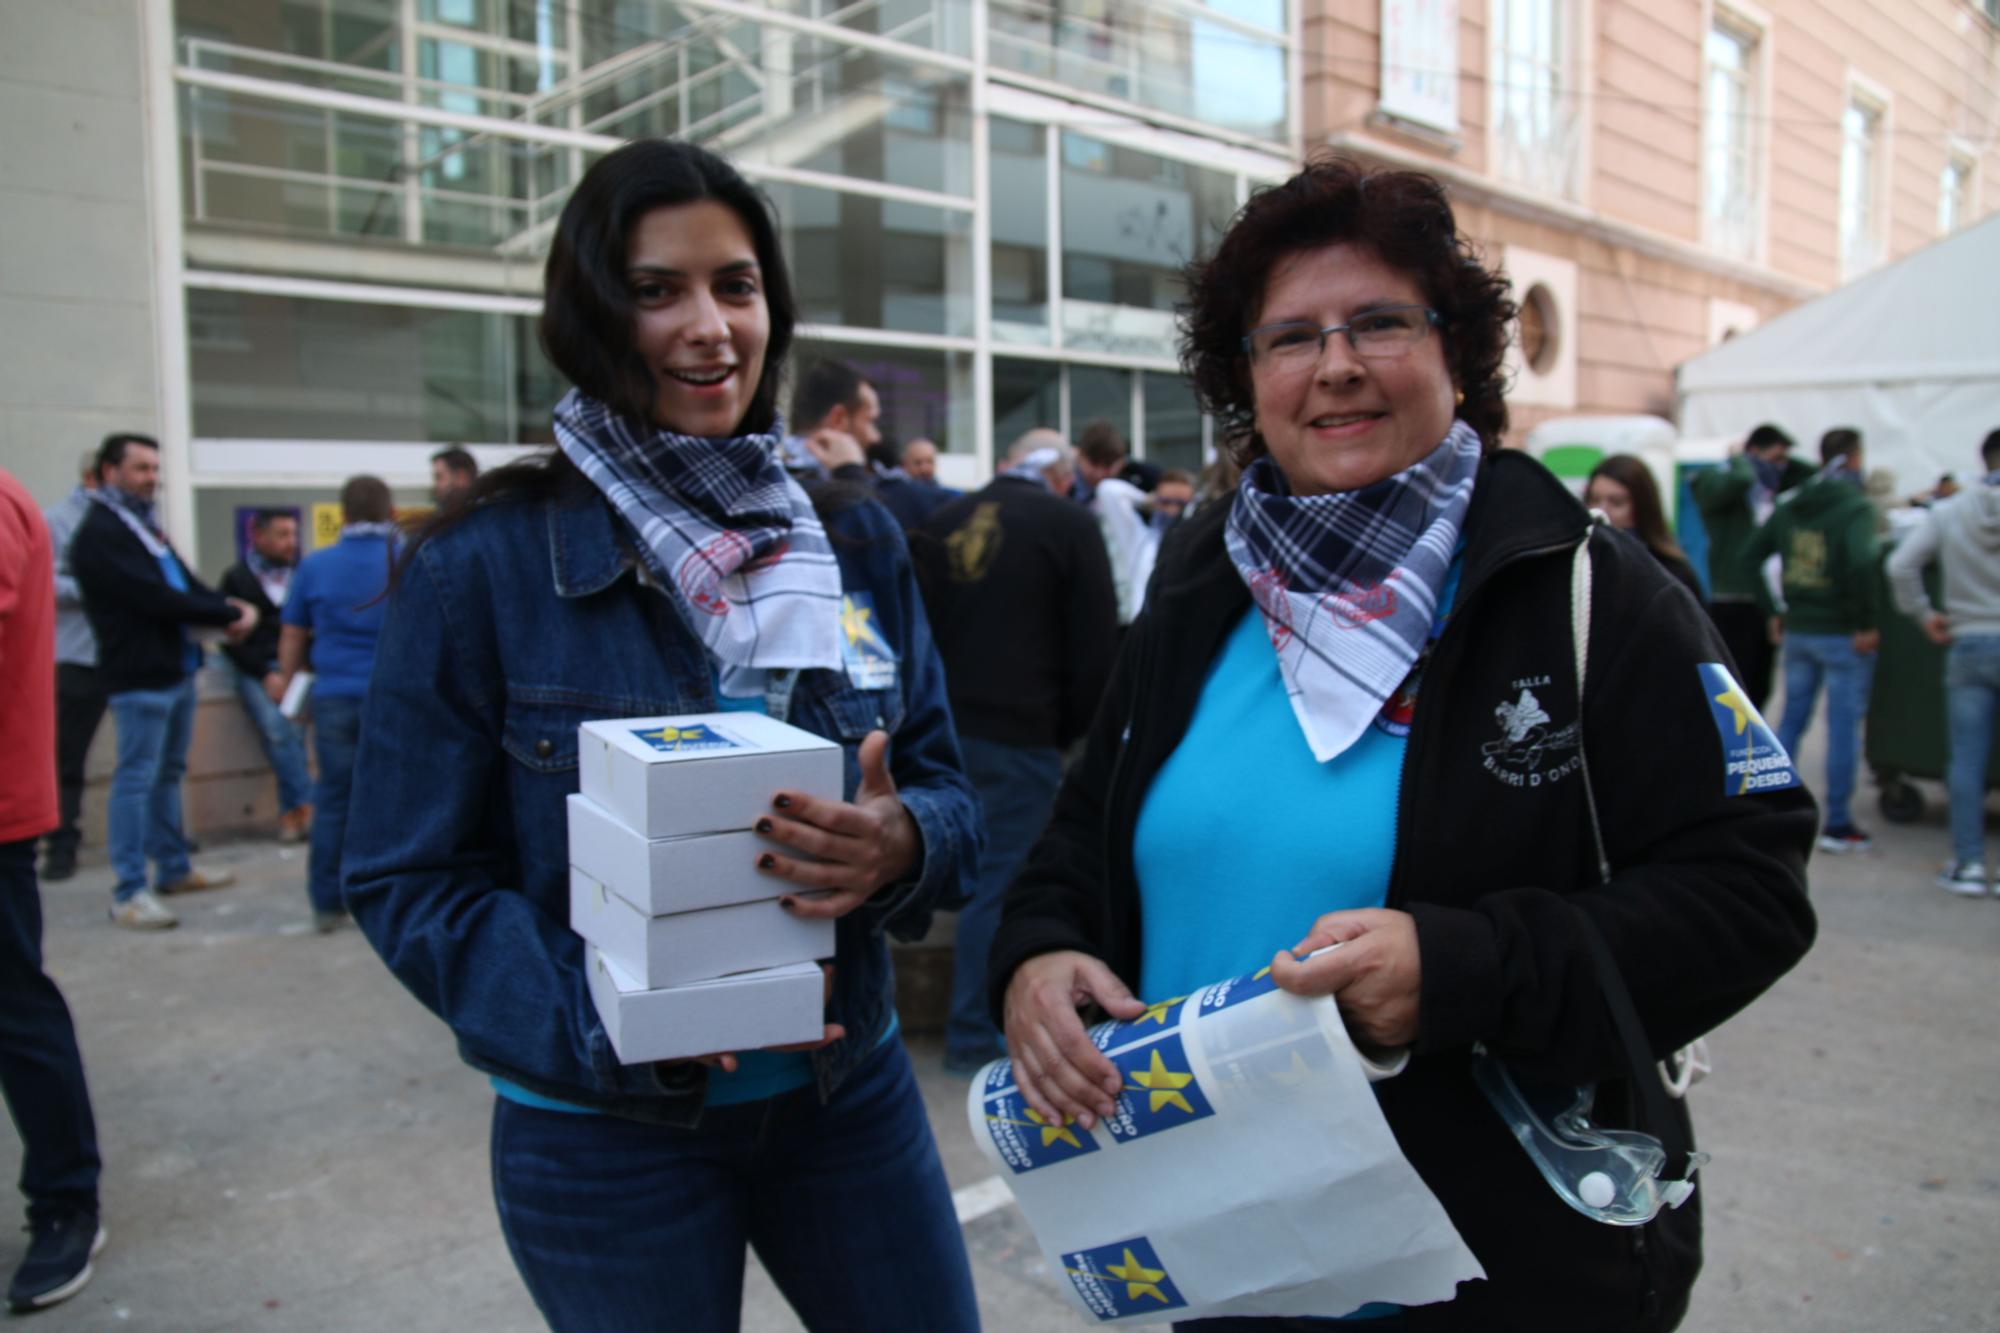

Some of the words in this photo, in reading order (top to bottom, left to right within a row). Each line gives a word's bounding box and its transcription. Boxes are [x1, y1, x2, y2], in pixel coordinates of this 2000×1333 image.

[1512, 675, 1551, 689] FALLA
[1727, 752, 1791, 776] PEQUEÑO
[1745, 771, 1792, 790] DESEO
